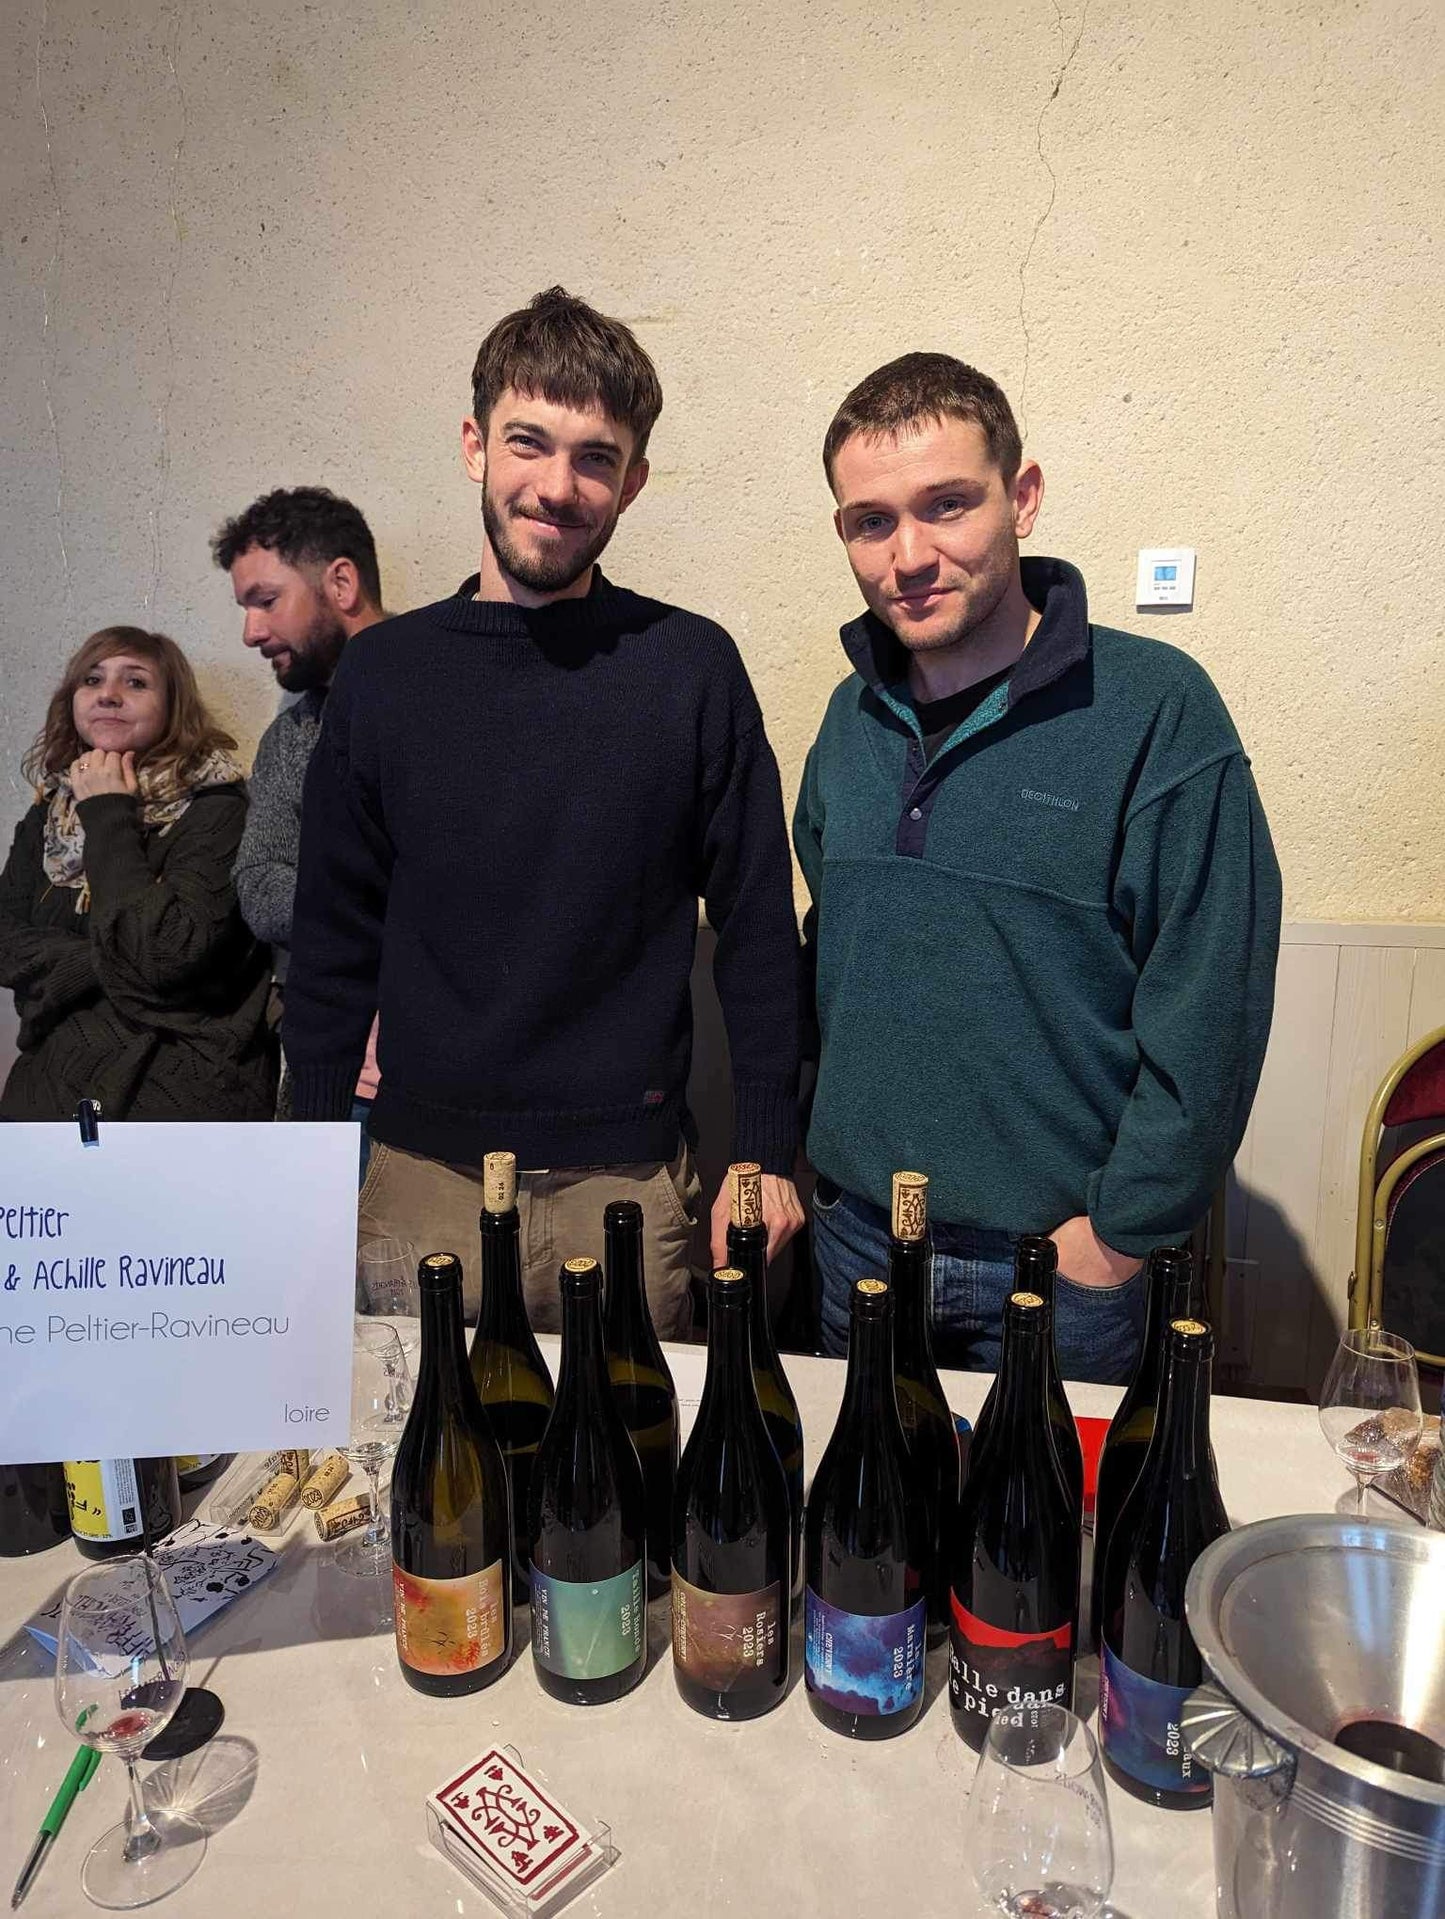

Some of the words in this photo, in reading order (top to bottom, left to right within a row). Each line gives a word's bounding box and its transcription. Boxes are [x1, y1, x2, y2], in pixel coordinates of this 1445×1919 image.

[1020, 788, 1080, 812] DECATHLON
[4, 1263, 21, 1291] &
[119, 1255, 226, 1289] Ravineau
[48, 1311, 290, 1343] Peltier-Ravineau
[284, 1402, 331, 1424] loire
[742, 1625, 755, 1658] 2023
[892, 1645, 905, 1679] 2023
[1006, 1682, 1067, 1704] dans
[1165, 1721, 1180, 1756] 2023
[1182, 1746, 1193, 1779] aux
